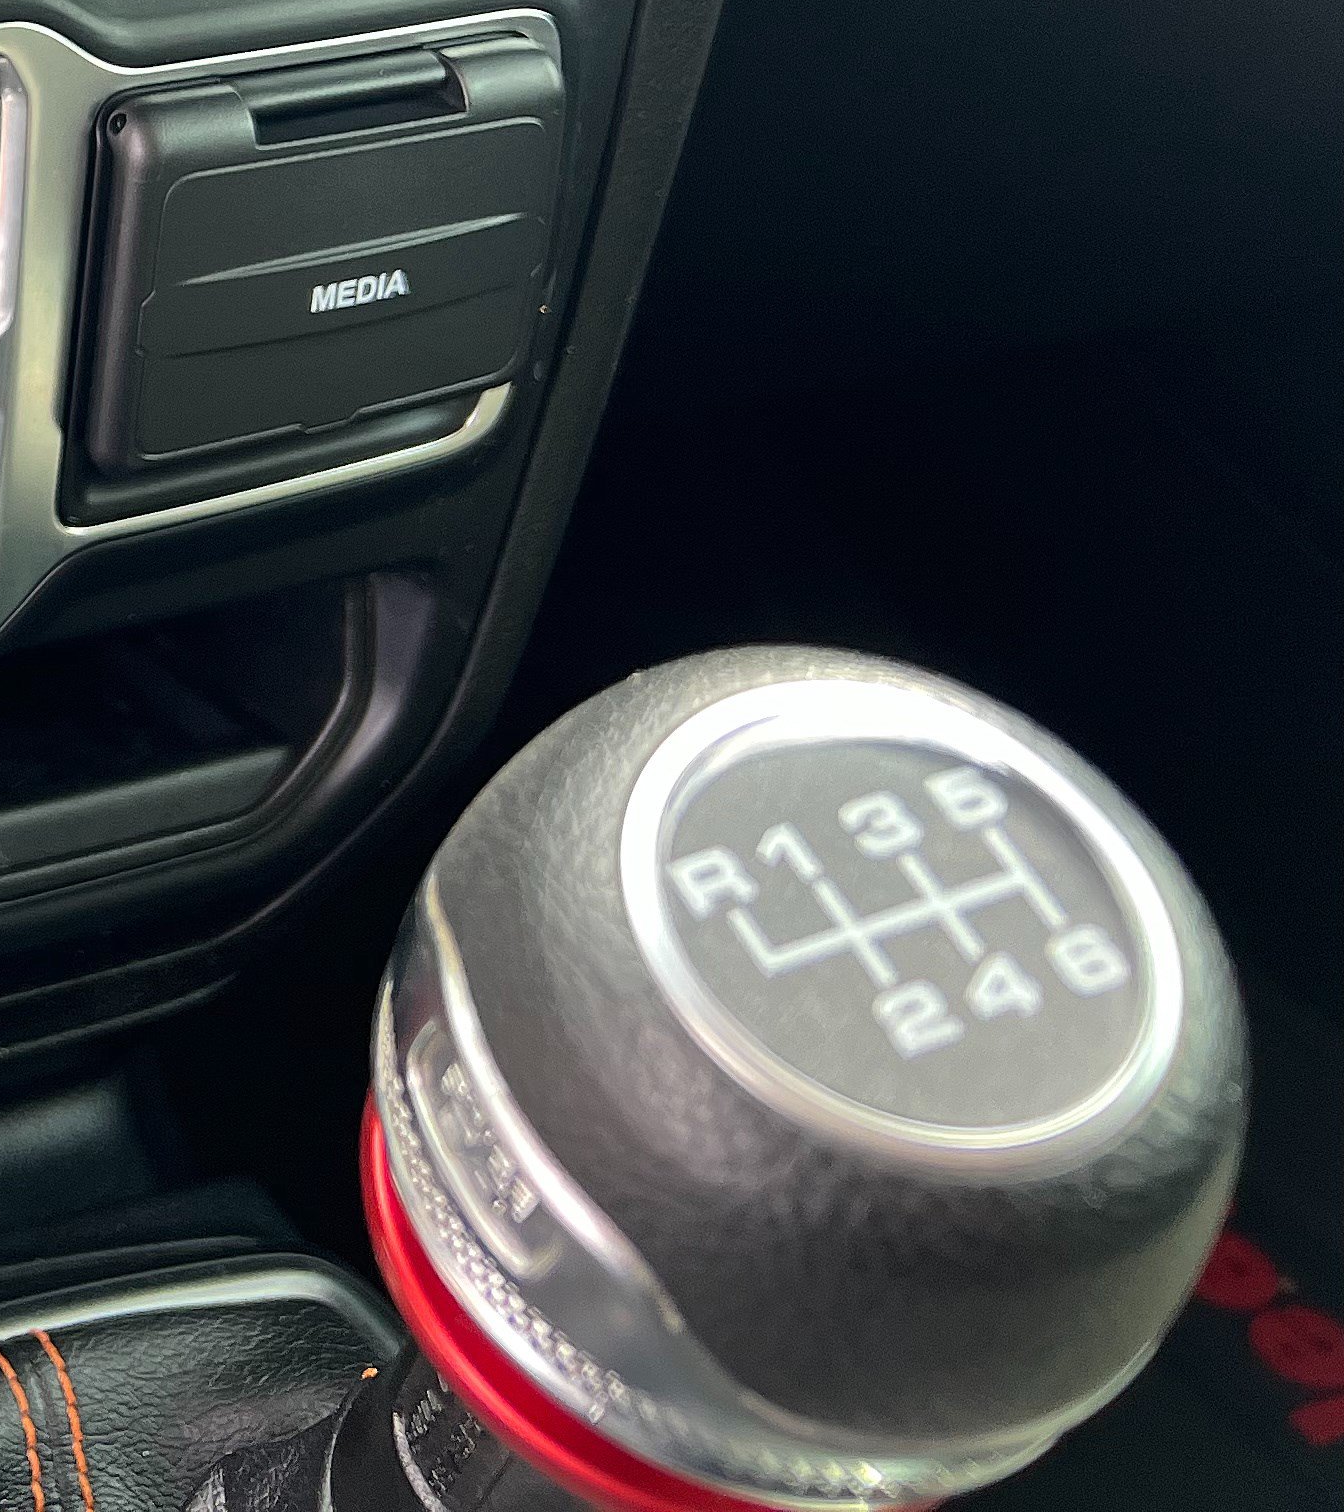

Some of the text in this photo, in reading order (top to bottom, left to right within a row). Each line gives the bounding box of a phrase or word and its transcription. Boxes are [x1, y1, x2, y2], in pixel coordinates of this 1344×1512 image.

[310, 268, 411, 314] MEDIA
[667, 766, 1009, 919] R 1 3 5
[872, 979, 966, 1061] 2
[963, 949, 1044, 1021] 4
